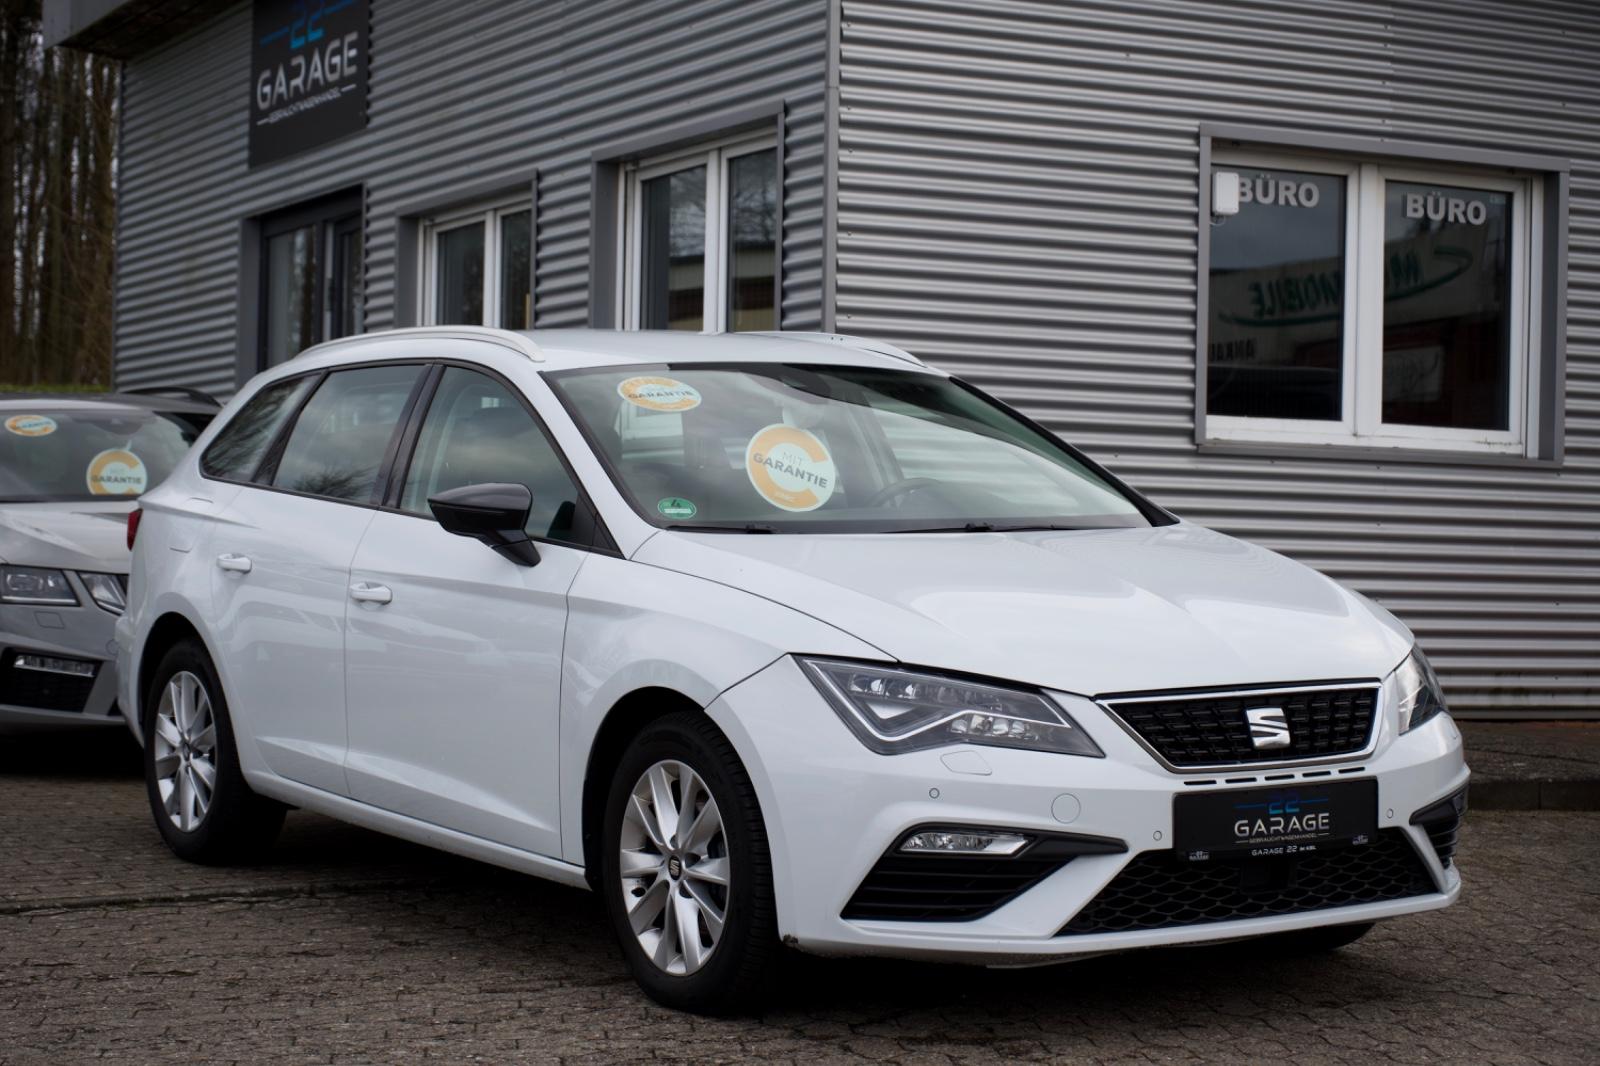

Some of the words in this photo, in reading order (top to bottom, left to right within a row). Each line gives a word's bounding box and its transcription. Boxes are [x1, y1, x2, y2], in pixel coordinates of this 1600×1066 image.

[257, 30, 359, 111] GARAGE
[1239, 174, 1320, 208] BÜRO
[1406, 190, 1487, 226] BÜRO
[753, 452, 829, 489] GARANTIE
[783, 452, 804, 467] MIT
[1268, 791, 1300, 815] 22
[1234, 812, 1331, 838] GARAGE
[1251, 847, 1284, 856] GARAGE
[1286, 845, 1298, 853] 22
